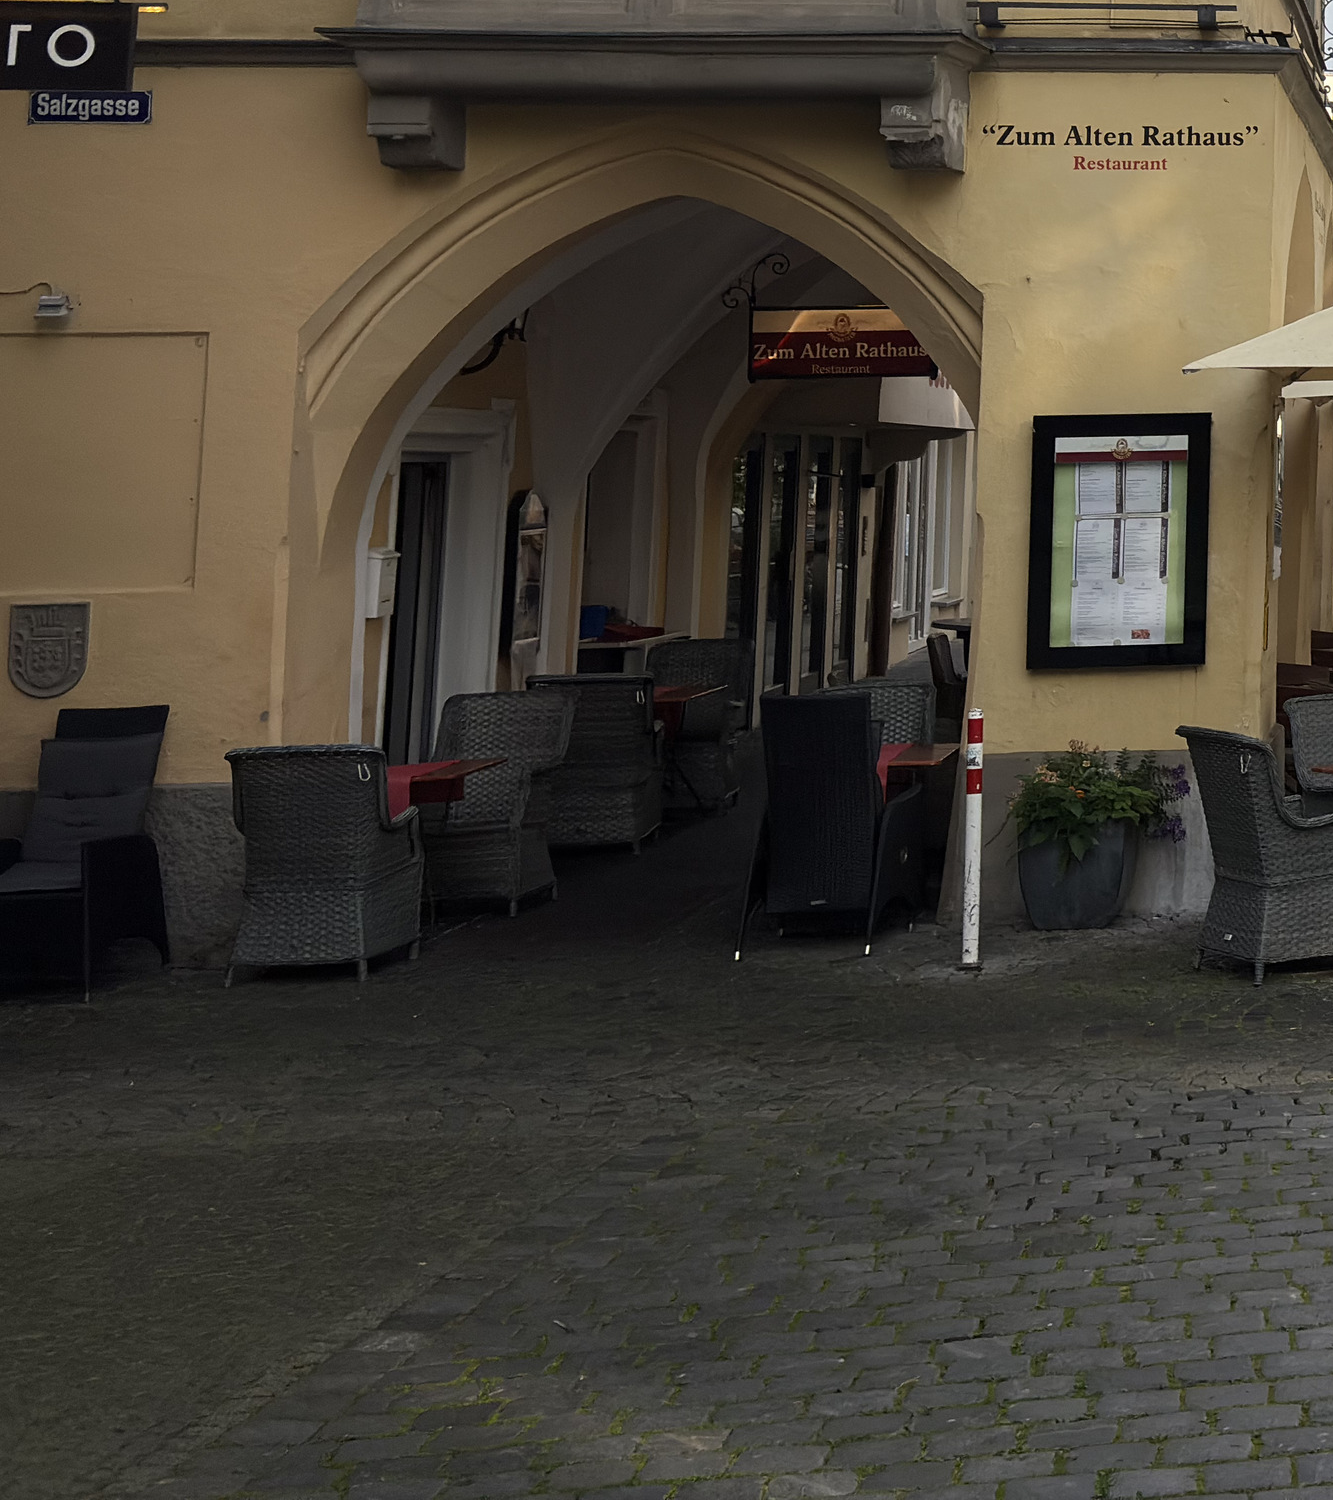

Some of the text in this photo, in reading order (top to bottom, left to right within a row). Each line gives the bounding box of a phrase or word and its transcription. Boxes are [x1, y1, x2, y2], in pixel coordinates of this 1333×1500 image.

[36, 93, 140, 121] Salzgasse
[1063, 125, 1135, 147] Alten
[1072, 155, 1168, 172] Restaurant
[753, 341, 929, 360] Zum Alten Rathaus
[811, 364, 870, 375] Restaurant
